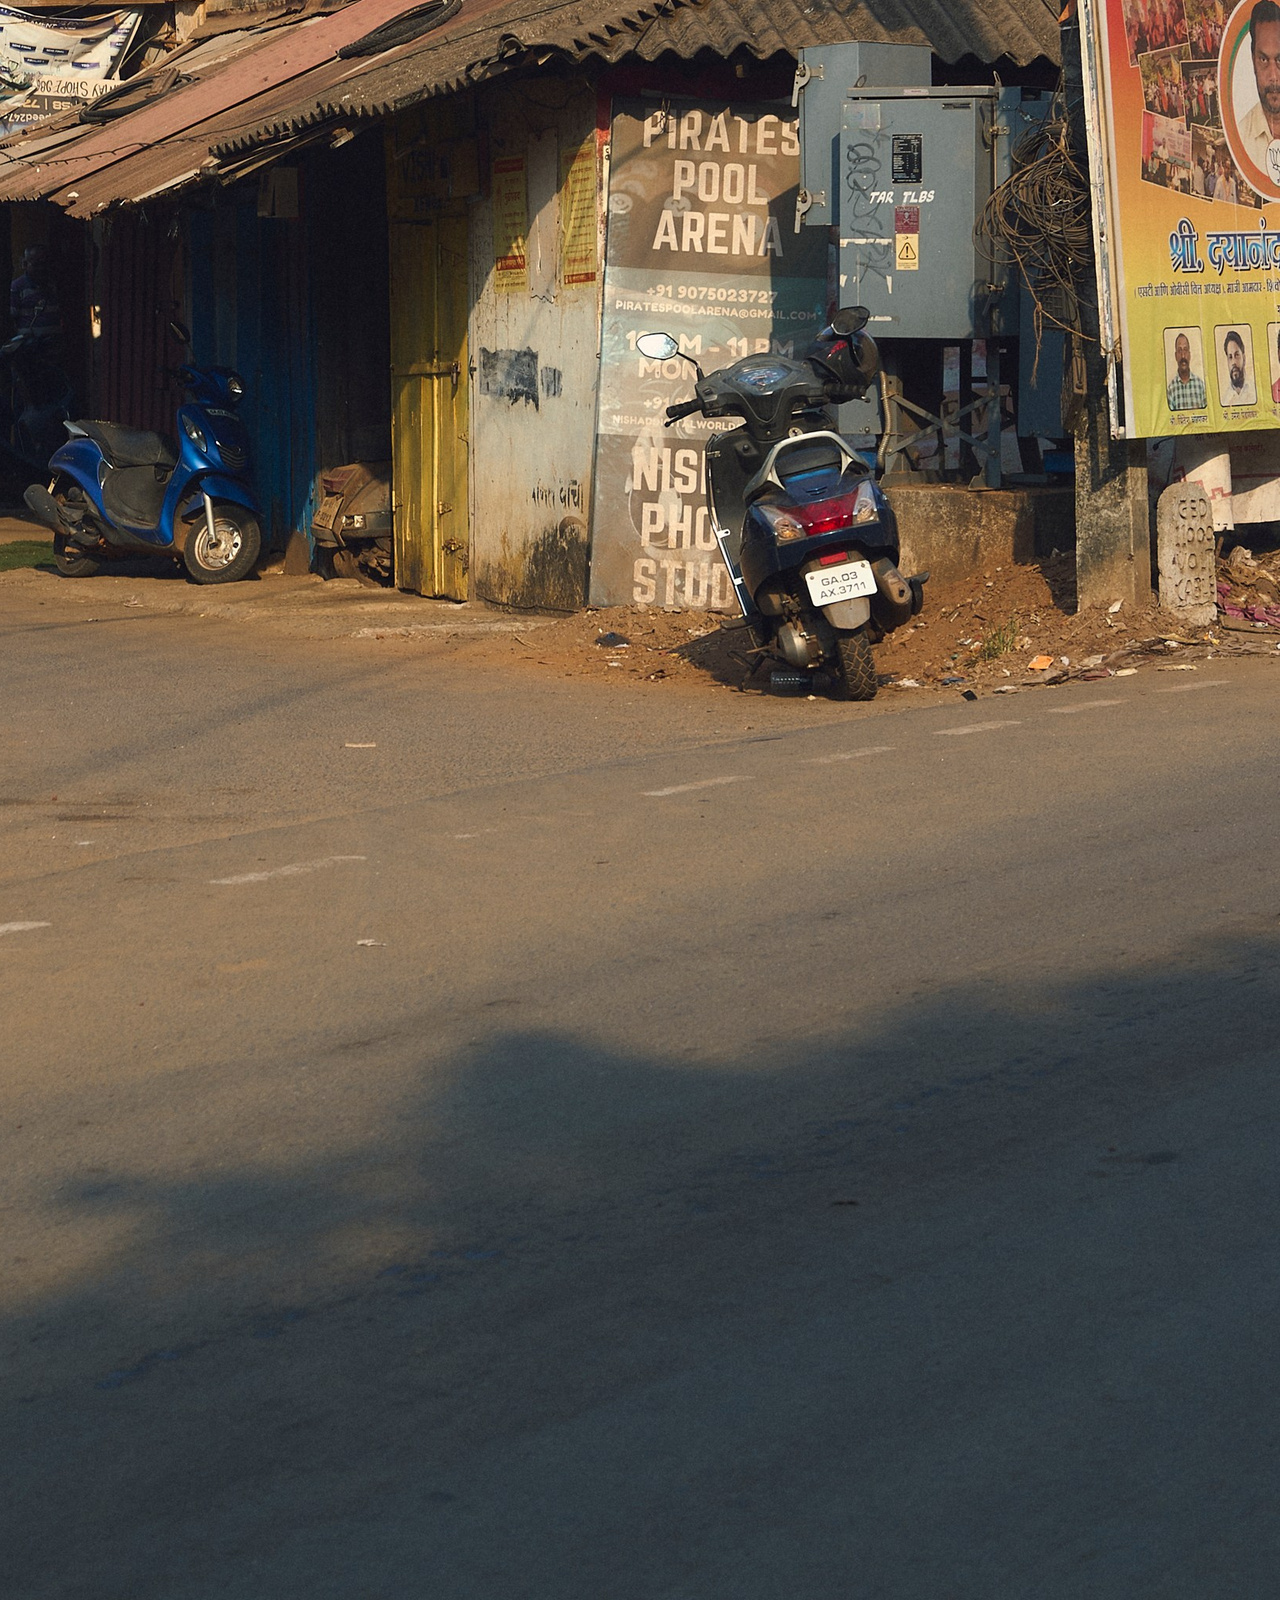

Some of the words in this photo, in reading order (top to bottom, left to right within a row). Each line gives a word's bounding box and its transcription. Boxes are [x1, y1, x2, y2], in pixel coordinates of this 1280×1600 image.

[642, 109, 800, 157] PIRATES
[673, 159, 768, 206] POOL
[869, 191, 894, 204] TAR
[902, 190, 935, 204] TLBS
[652, 210, 784, 257] ARENA
[1169, 217, 1204, 273] श्री.
[646, 284, 673, 298] +91
[678, 284, 778, 303] 9075023727
[615, 300, 818, 321] PIRATESPOOLARENA@GMAIL.COM
[726, 337, 748, 357] 11
[755, 338, 795, 360] PM
[632, 446, 706, 495] NIS
[632, 557, 735, 609] STUD
[820, 581, 867, 600] AX.3711
[821, 571, 858, 587] GA.03
[1175, 575, 1215, 601] CABLE
